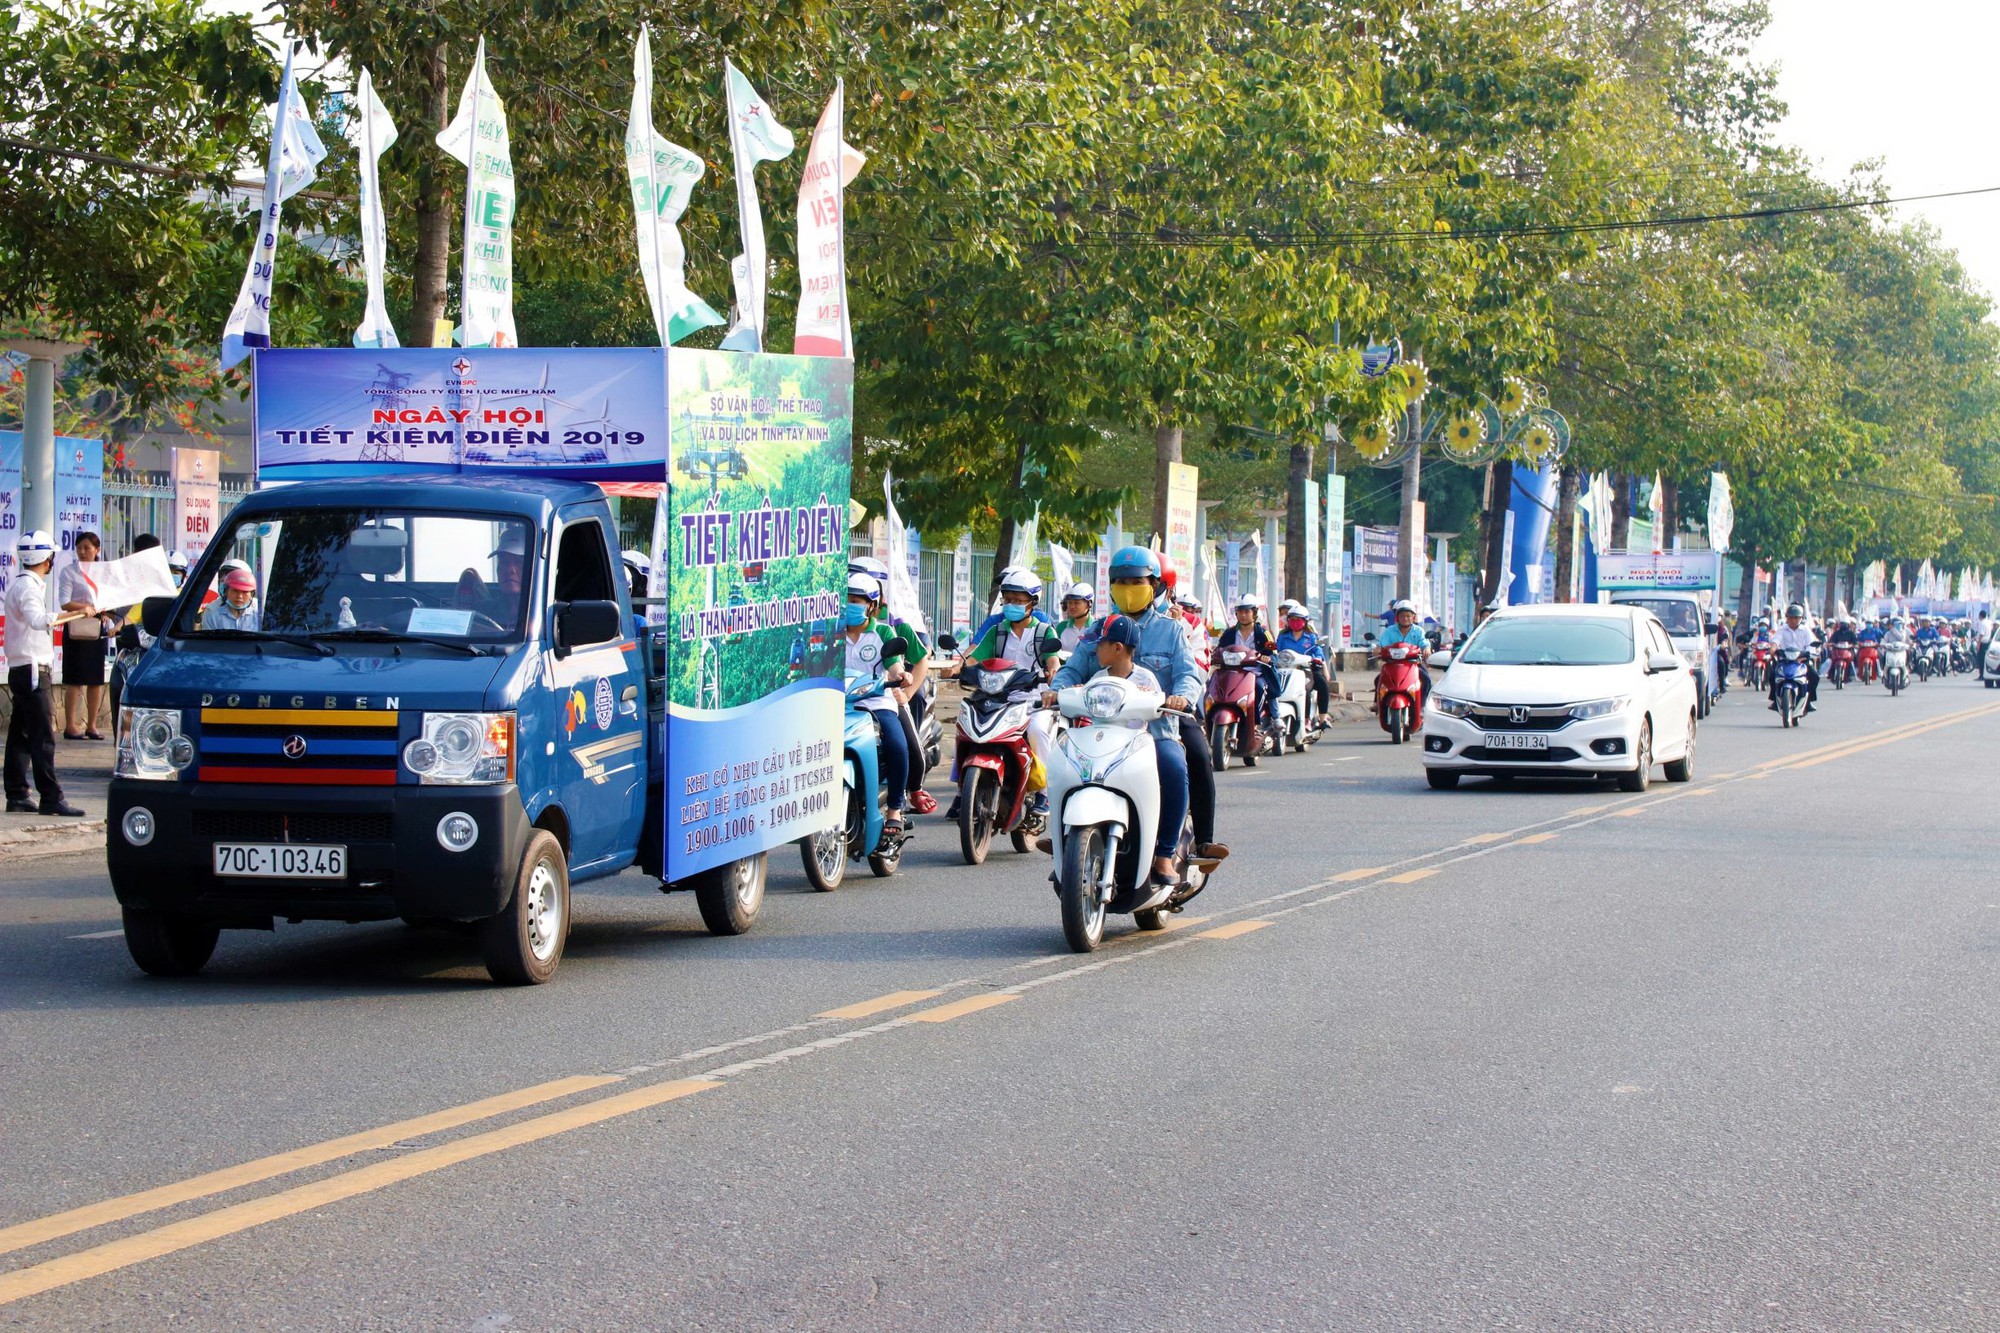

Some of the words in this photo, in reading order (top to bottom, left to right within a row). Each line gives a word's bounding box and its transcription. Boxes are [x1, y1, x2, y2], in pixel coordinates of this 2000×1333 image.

[396, 387, 427, 395] CÔNG
[710, 393, 724, 412] SỞ
[727, 396, 748, 412] VĂN
[777, 392, 795, 413] THỂ
[798, 399, 823, 414] THAO
[373, 406, 471, 424] NGÀY
[483, 406, 544, 427] HỘI
[275, 425, 354, 444] TIẾT
[366, 427, 454, 448] KIỆM
[465, 427, 550, 448] ĐIỆN
[563, 431, 645, 444] 2019
[701, 424, 715, 441] VÀ
[718, 427, 733, 441] DU
[735, 427, 758, 446] LỊCH
[761, 422, 785, 441] TỈNH
[786, 425, 803, 440] TÂY
[806, 427, 829, 440] NINH
[681, 492, 731, 568] TIẾT
[738, 496, 791, 571] KIỆM
[797, 494, 843, 565] ĐIỆN
[681, 608, 696, 640] LÀ
[699, 604, 728, 637] THÂN
[730, 601, 761, 636] THIỆN
[764, 596, 780, 628] VỚI
[783, 592, 801, 624] MÔI
[803, 589, 840, 622] TRƯỜNG
[201, 694, 399, 710] DONGBEN
[1487, 735, 1545, 748] 70A-191.34
[685, 771, 709, 794] KHI
[713, 763, 729, 787] CÓ
[733, 760, 759, 782] NHU
[763, 747, 785, 773] CẦU
[789, 741, 802, 766] VỀ
[805, 738, 831, 763] ĐIỆN
[681, 797, 710, 825] LIÊN
[714, 791, 730, 816] HỆ
[734, 784, 766, 810] TỔNG
[770, 775, 790, 797] ĐÀI
[794, 764, 834, 790] TTCSKH
[685, 813, 755, 853] 1900.1006
[770, 790, 829, 828] 1900.9000
[218, 846, 342, 874] 70C-103.46
